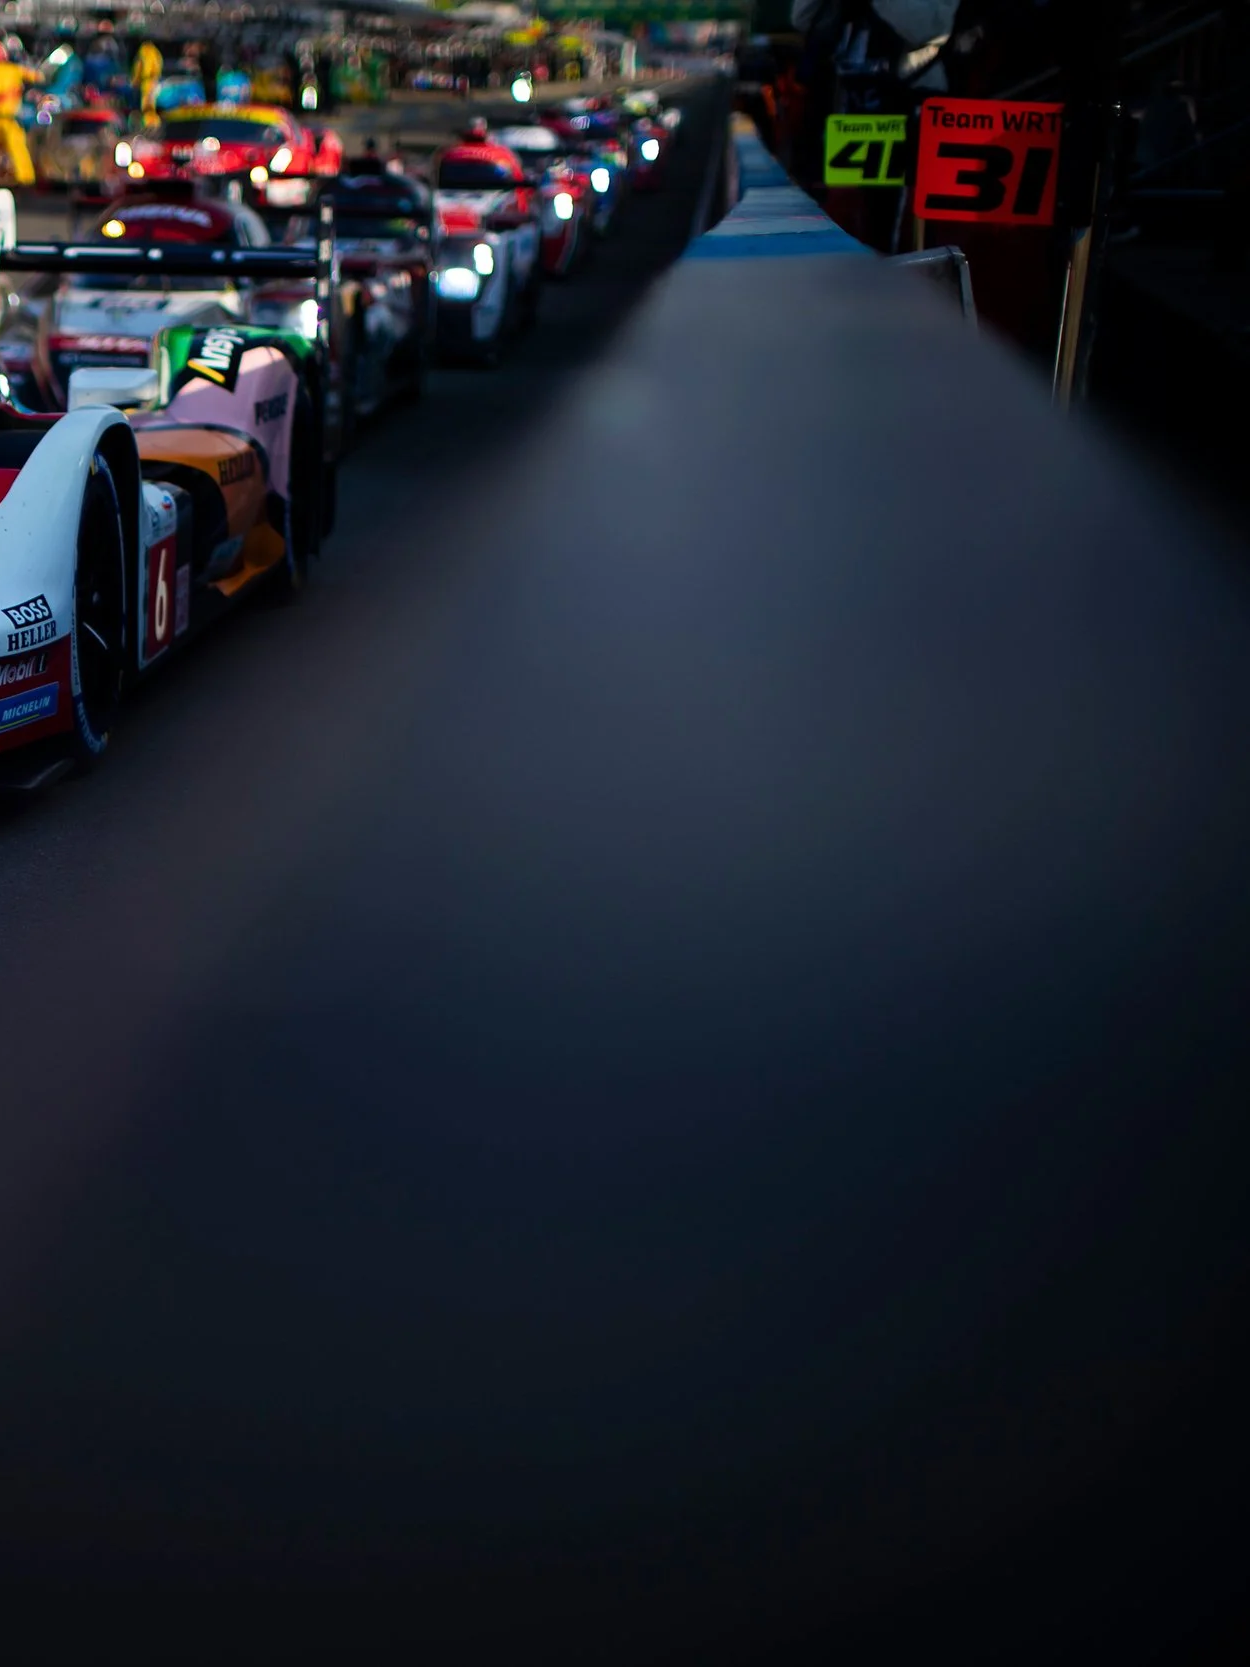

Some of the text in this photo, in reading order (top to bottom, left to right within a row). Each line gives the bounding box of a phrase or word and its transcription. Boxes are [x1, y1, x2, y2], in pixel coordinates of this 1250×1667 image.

[833, 119, 874, 134] Team
[926, 106, 1065, 133] Team WRT
[924, 141, 1054, 216] 31
[155, 548, 168, 642] 6
[8, 597, 50, 626] BOSS
[7, 620, 58, 652] HELLER
[2, 695, 51, 722] MICHELIN
